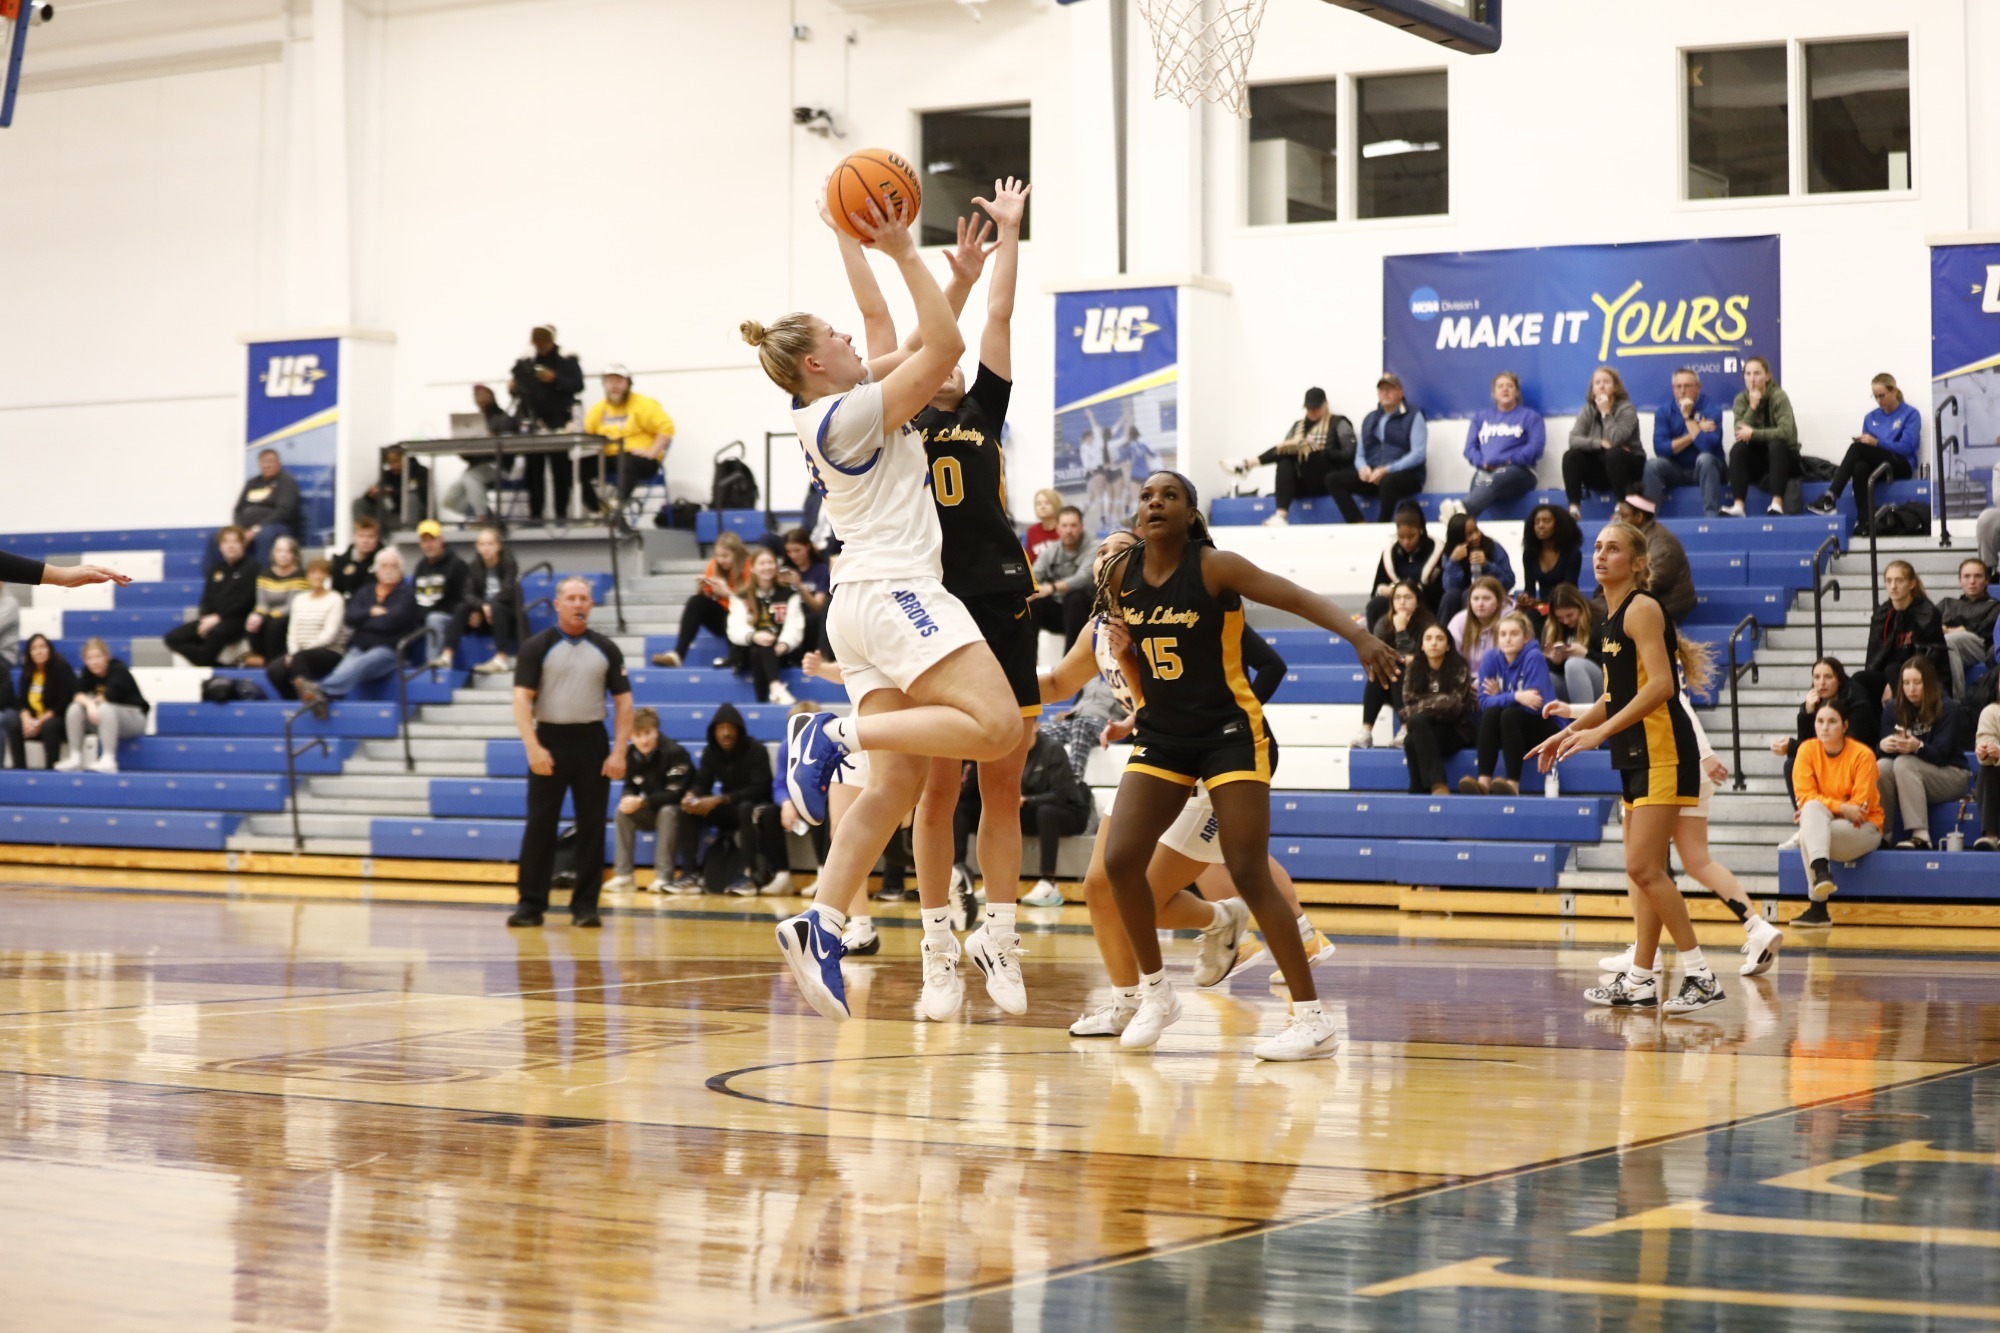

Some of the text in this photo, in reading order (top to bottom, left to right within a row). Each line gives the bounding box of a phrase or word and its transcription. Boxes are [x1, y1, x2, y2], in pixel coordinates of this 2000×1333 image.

[1436, 280, 1749, 361] MAKE IT YOURS
[1441, 299, 1474, 311] Division
[1082, 305, 1150, 354] UC
[265, 354, 320, 397] UC
[933, 424, 984, 446] Liberty
[932, 456, 965, 507] 0
[891, 590, 939, 638] ARROWS
[1123, 606, 1200, 629] West Liberty
[1141, 637, 1184, 681] 15
